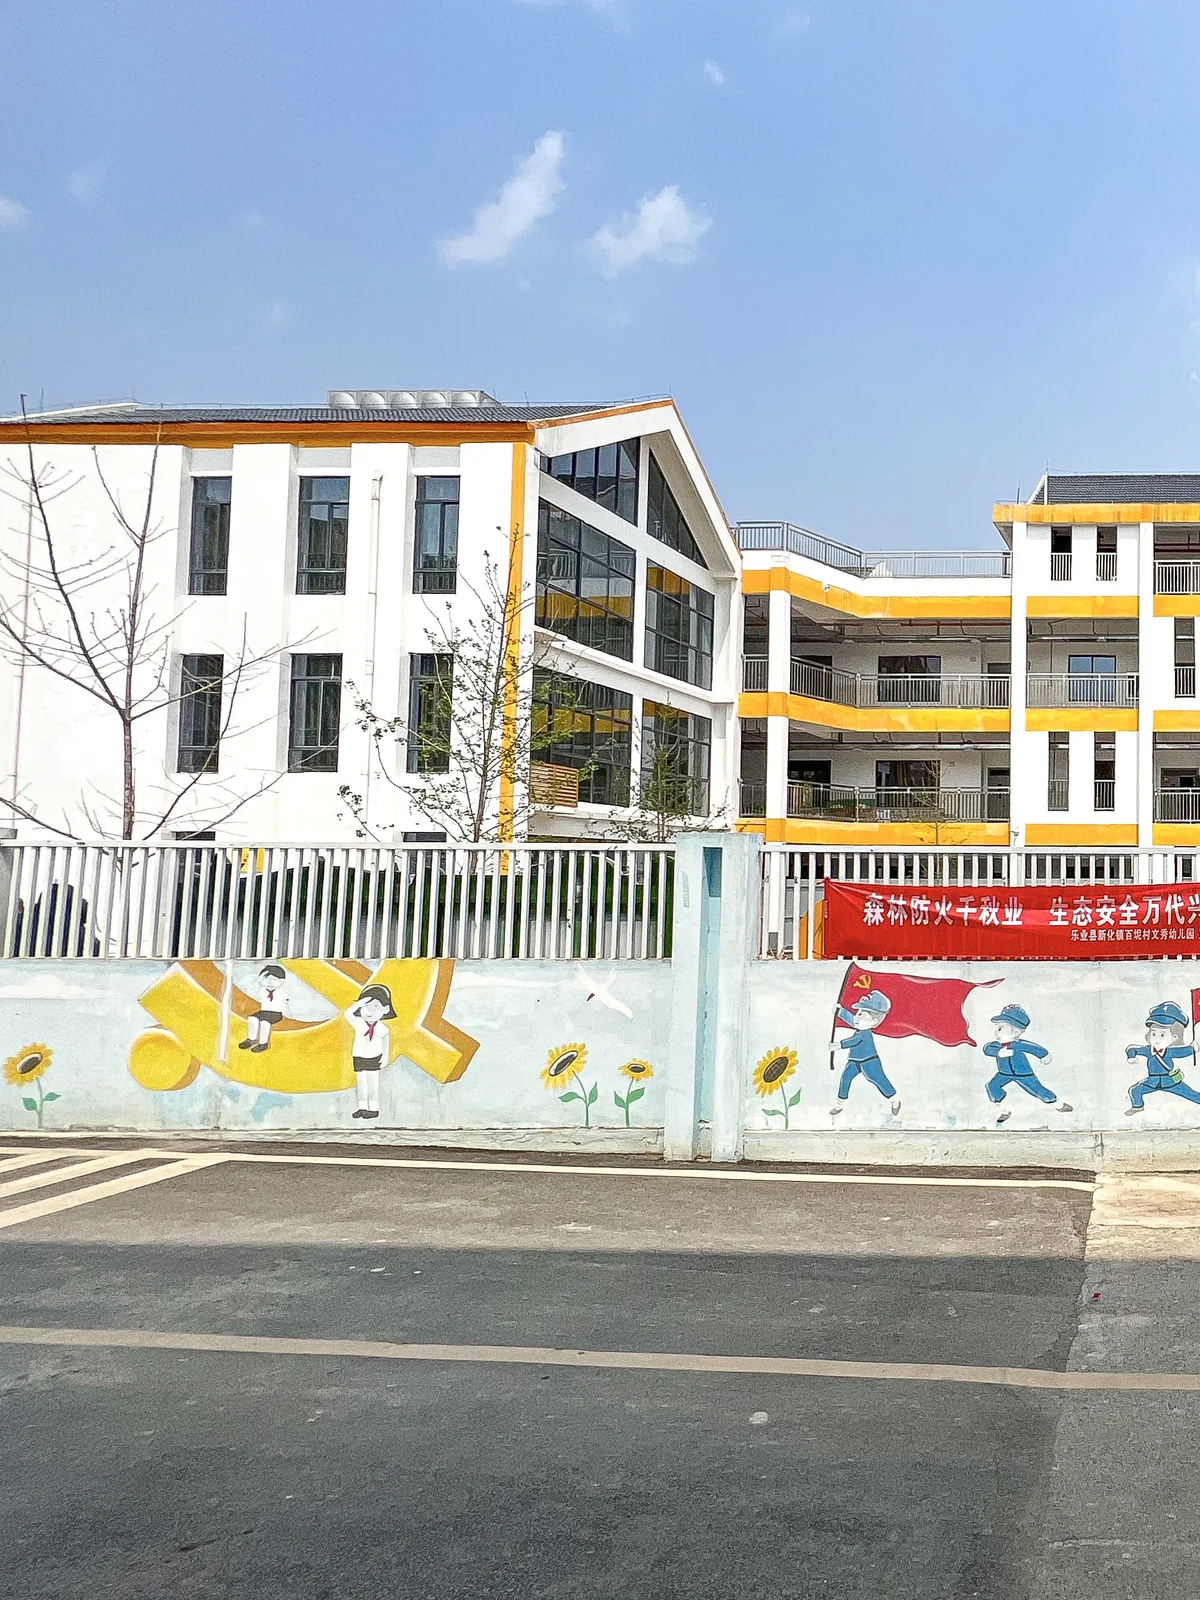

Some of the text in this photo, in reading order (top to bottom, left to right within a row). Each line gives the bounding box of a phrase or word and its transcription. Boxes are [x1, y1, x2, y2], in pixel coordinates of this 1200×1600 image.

[863, 893, 1023, 926] 森林防火千秋业
